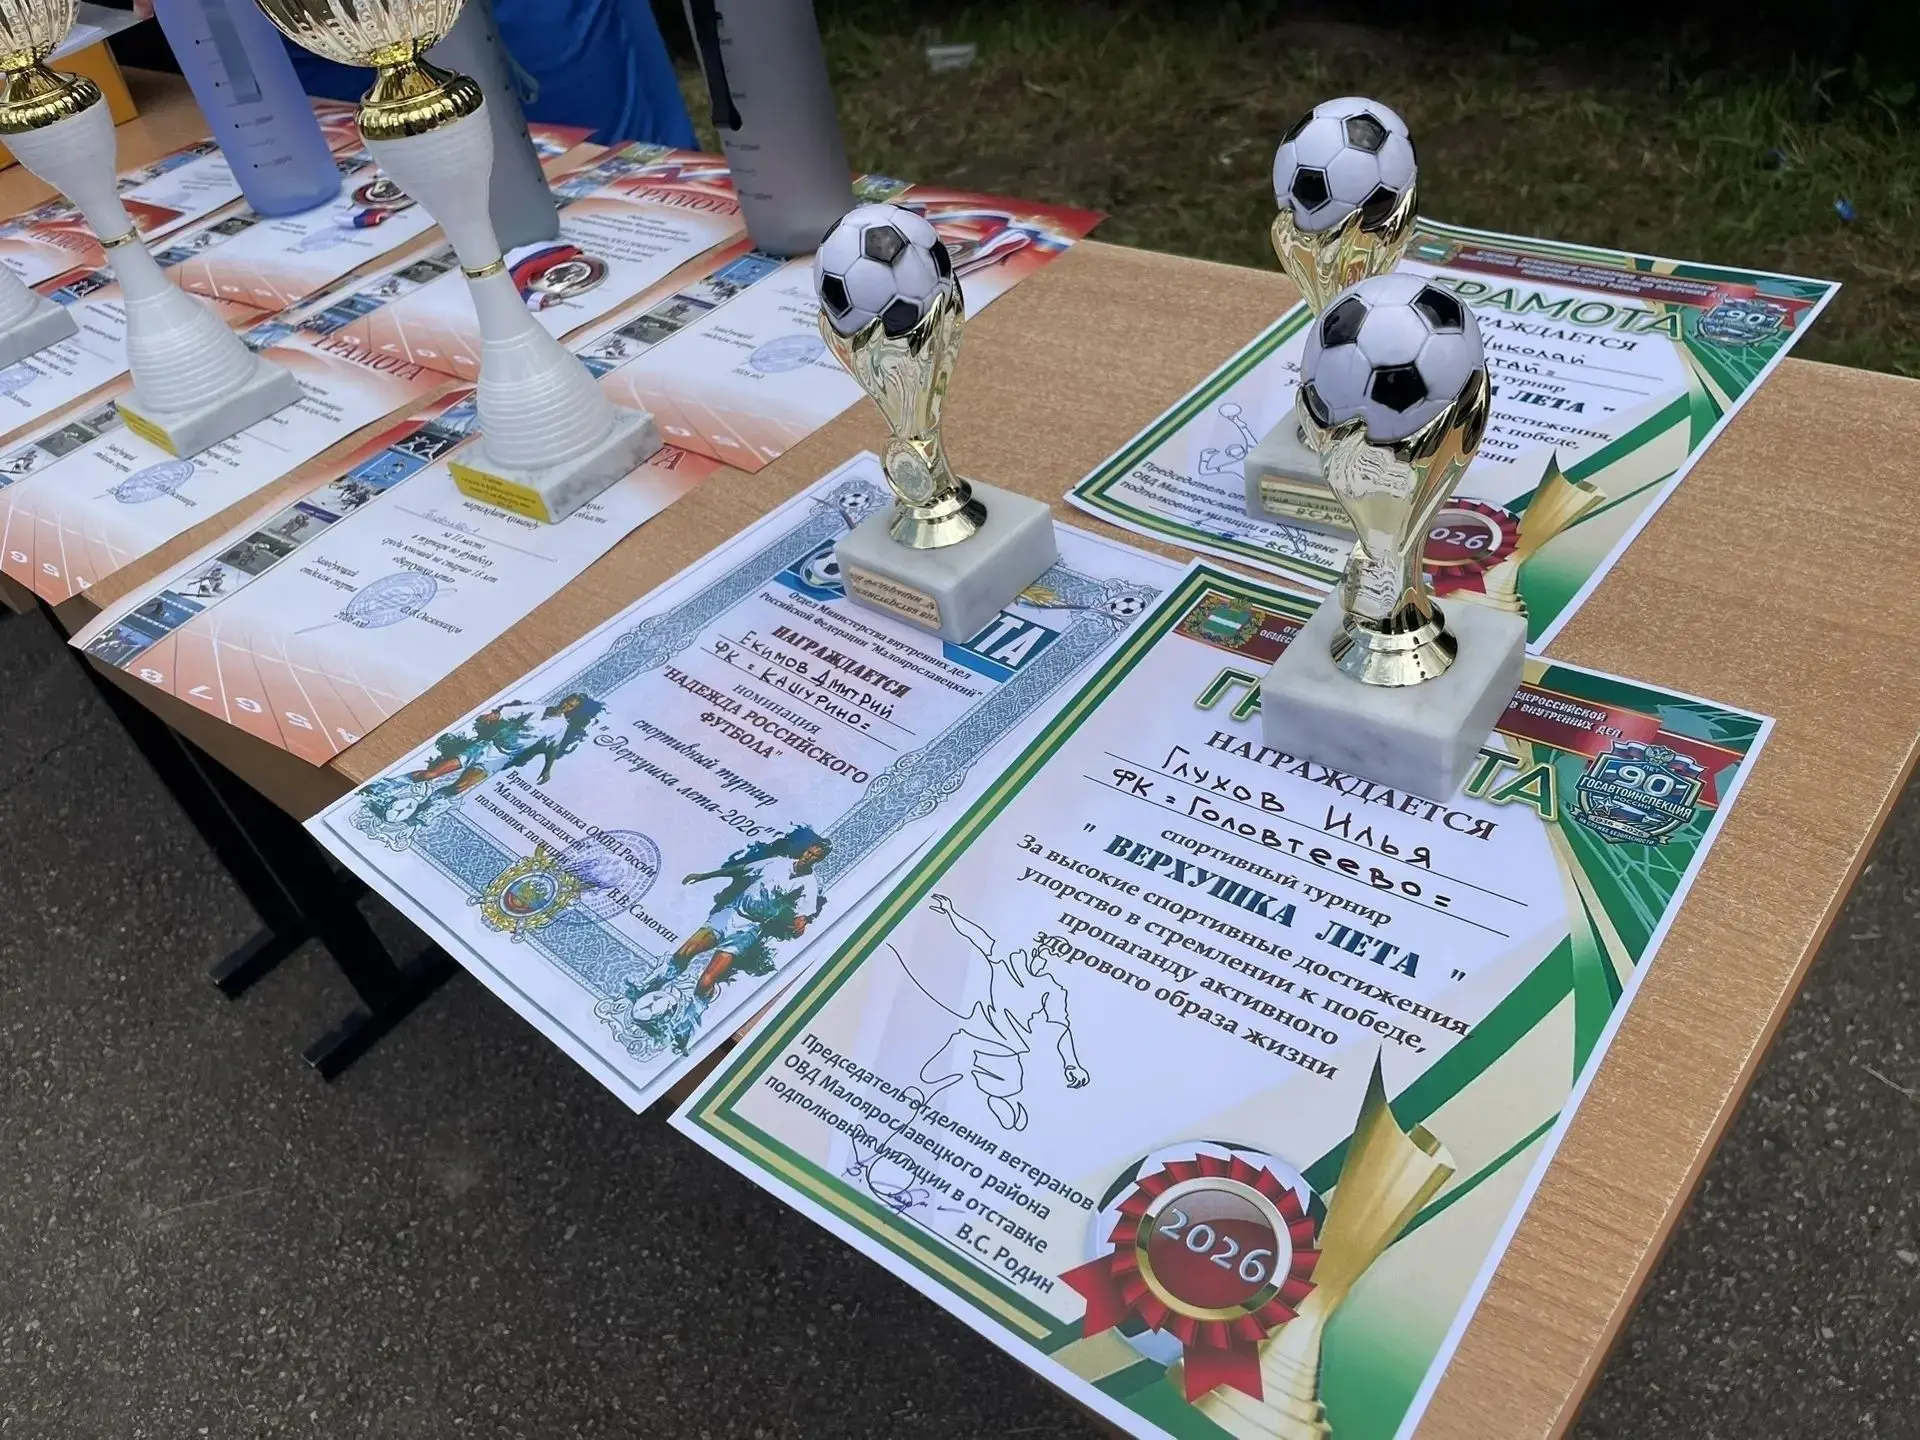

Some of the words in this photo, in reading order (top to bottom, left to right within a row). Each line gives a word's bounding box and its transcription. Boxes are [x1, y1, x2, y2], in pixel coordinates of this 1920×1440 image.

[312, 335, 424, 381] ГРАМОТА
[1475, 314, 1638, 351] РАЖДАЕТСЯ
[1502, 374, 1566, 394] турнир
[1508, 389, 1586, 413] ЛЕТА
[1508, 427, 1580, 449] победе,
[1120, 481, 1204, 516] подполковник
[1131, 471, 1159, 489] ОВД
[1142, 461, 1226, 497] Председатель
[1428, 527, 1489, 550] 026
[715, 641, 739, 663] ФК
[759, 592, 814, 621] Российской
[813, 616, 869, 648] Федерации
[871, 643, 983, 698] "Малоярославецкий"
[771, 625, 912, 698] НАГРАЖДАЕТСЯ
[789, 592, 819, 609] Отдел
[820, 604, 887, 641] Министерства
[886, 634, 950, 671] внутренних
[948, 665, 972, 680] дел
[140, 668, 163, 684] 8
[188, 685, 214, 700] 7
[235, 697, 262, 713] 6
[285, 711, 313, 730] 5
[663, 665, 745, 715] "НАДЕЖДА
[741, 709, 869, 784] РОССИЙСКОГО
[732, 684, 822, 735] номинация
[1520, 703, 1594, 731] ВНУТРЕННИХ
[1596, 722, 1623, 739] ДЕЛ
[633, 718, 719, 770] спортивный
[714, 766, 779, 809] турнир
[700, 711, 783, 759] ФУТБОЛА"
[494, 781, 591, 852] "Малоярославецкий"
[677, 785, 773, 838] лета-2026"
[1113, 768, 1154, 797] ФК
[1204, 730, 1499, 841] НАГРАЖДАЕТСЯ
[1580, 776, 1693, 819] ГОСАВТОИНСПЕКЦИЯ
[1614, 765, 1675, 798] 90
[1614, 795, 1651, 811] РОССИИ
[506, 770, 531, 792] Врио
[529, 788, 587, 829] начальника
[585, 825, 622, 854] ОМВД
[619, 848, 657, 878] России
[474, 794, 526, 834] полковник
[629, 904, 680, 944] Самохин
[1016, 834, 1043, 856] За
[1045, 849, 1140, 896] высокие
[1143, 891, 1293, 961] спортивные
[1161, 829, 1299, 890] спортивный
[1302, 883, 1392, 928] турнир
[1103, 834, 1297, 928] ВЕРХУШКА
[1315, 920, 1420, 979] ЛЕТА
[1017, 866, 1123, 917] упорство
[1124, 911, 1142, 926] в
[1144, 921, 1297, 994] стремлении
[1297, 986, 1320, 1004] к
[1322, 998, 1426, 1053] победе,
[1057, 912, 1198, 983] пропаганду
[1200, 976, 1339, 1046] активного
[1032, 930, 1151, 992] здорового
[1154, 990, 1239, 1035] образа
[1242, 1027, 1339, 1080] жизни
[784, 1054, 818, 1083] ОВД
[817, 1074, 983, 1180] Малоярославецкого
[980, 1172, 1051, 1221] района
[800, 1033, 906, 1103] Председатель
[908, 1096, 998, 1156] отделения
[999, 1149, 1095, 1212] ветеранов
[765, 1075, 876, 1149] подполковник
[876, 1143, 951, 1195] милиции
[949, 1187, 962, 1201] в
[965, 1197, 1048, 1253] отставке
[955, 1222, 989, 1254] В.С.
[993, 1247, 1055, 1294] Родин
[1159, 1207, 1272, 1283] 2026
